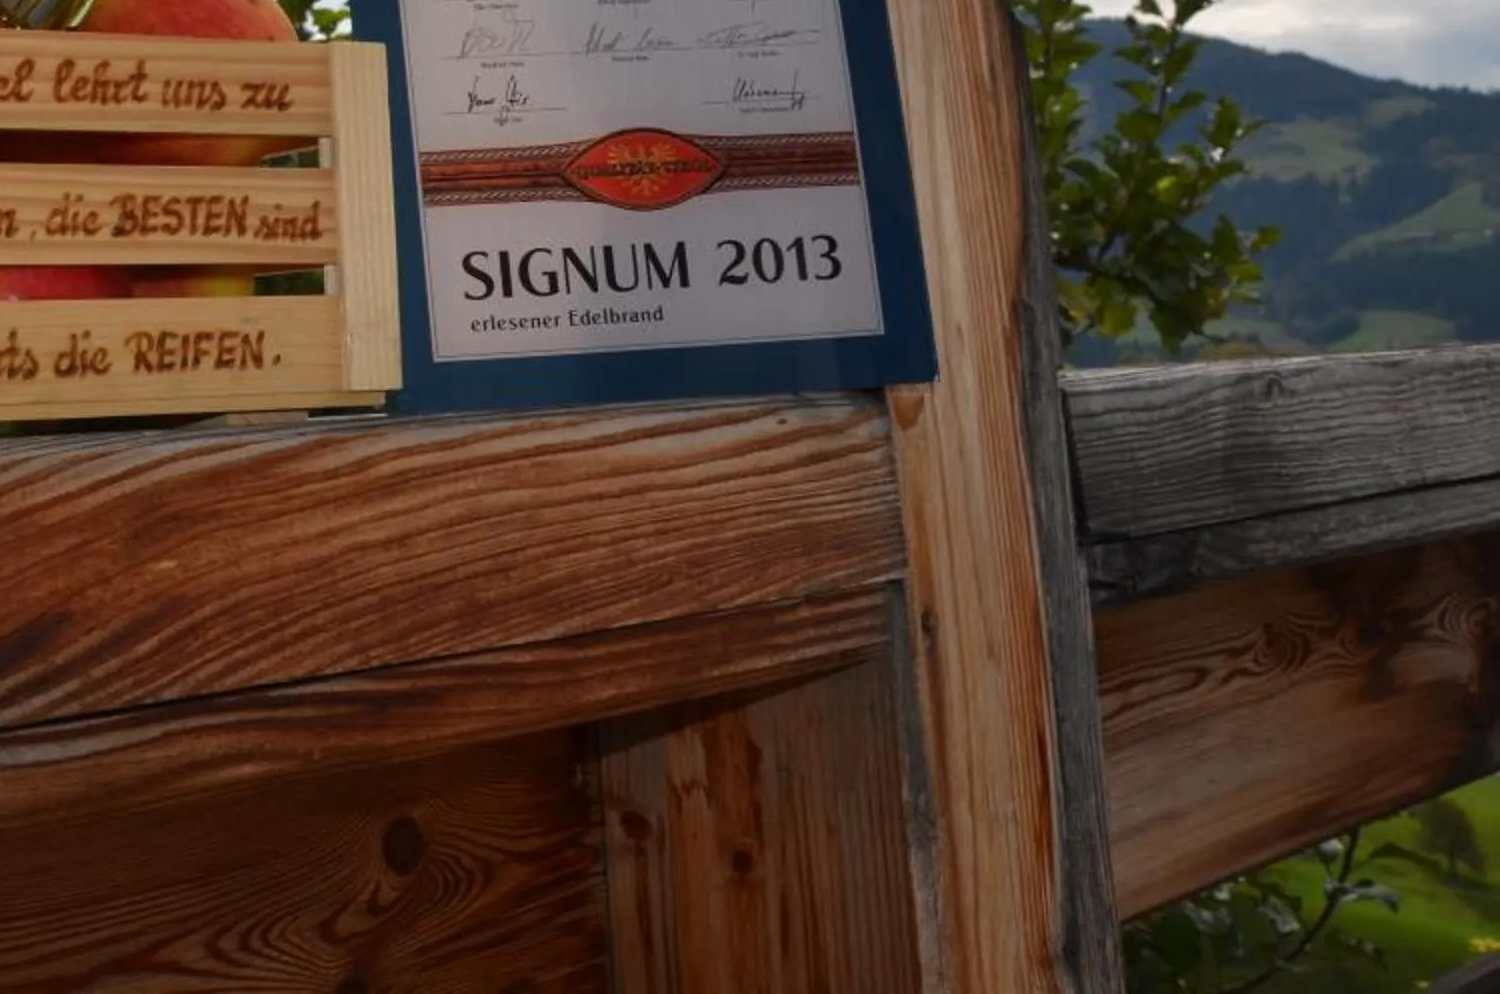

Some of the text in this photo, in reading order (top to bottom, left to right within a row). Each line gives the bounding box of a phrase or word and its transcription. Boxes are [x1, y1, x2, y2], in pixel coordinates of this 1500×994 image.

[52, 58, 150, 106] lehrt
[161, 78, 228, 111] uns
[240, 80, 293, 111] zu
[45, 192, 102, 238] die
[109, 192, 250, 239] BESTEN
[254, 200, 323, 241] sind
[461, 234, 843, 301] SIGNUM 2013
[470, 306, 665, 333] erlesener Edelbrand
[54, 329, 113, 379] die
[123, 329, 282, 374] REIFEN.
